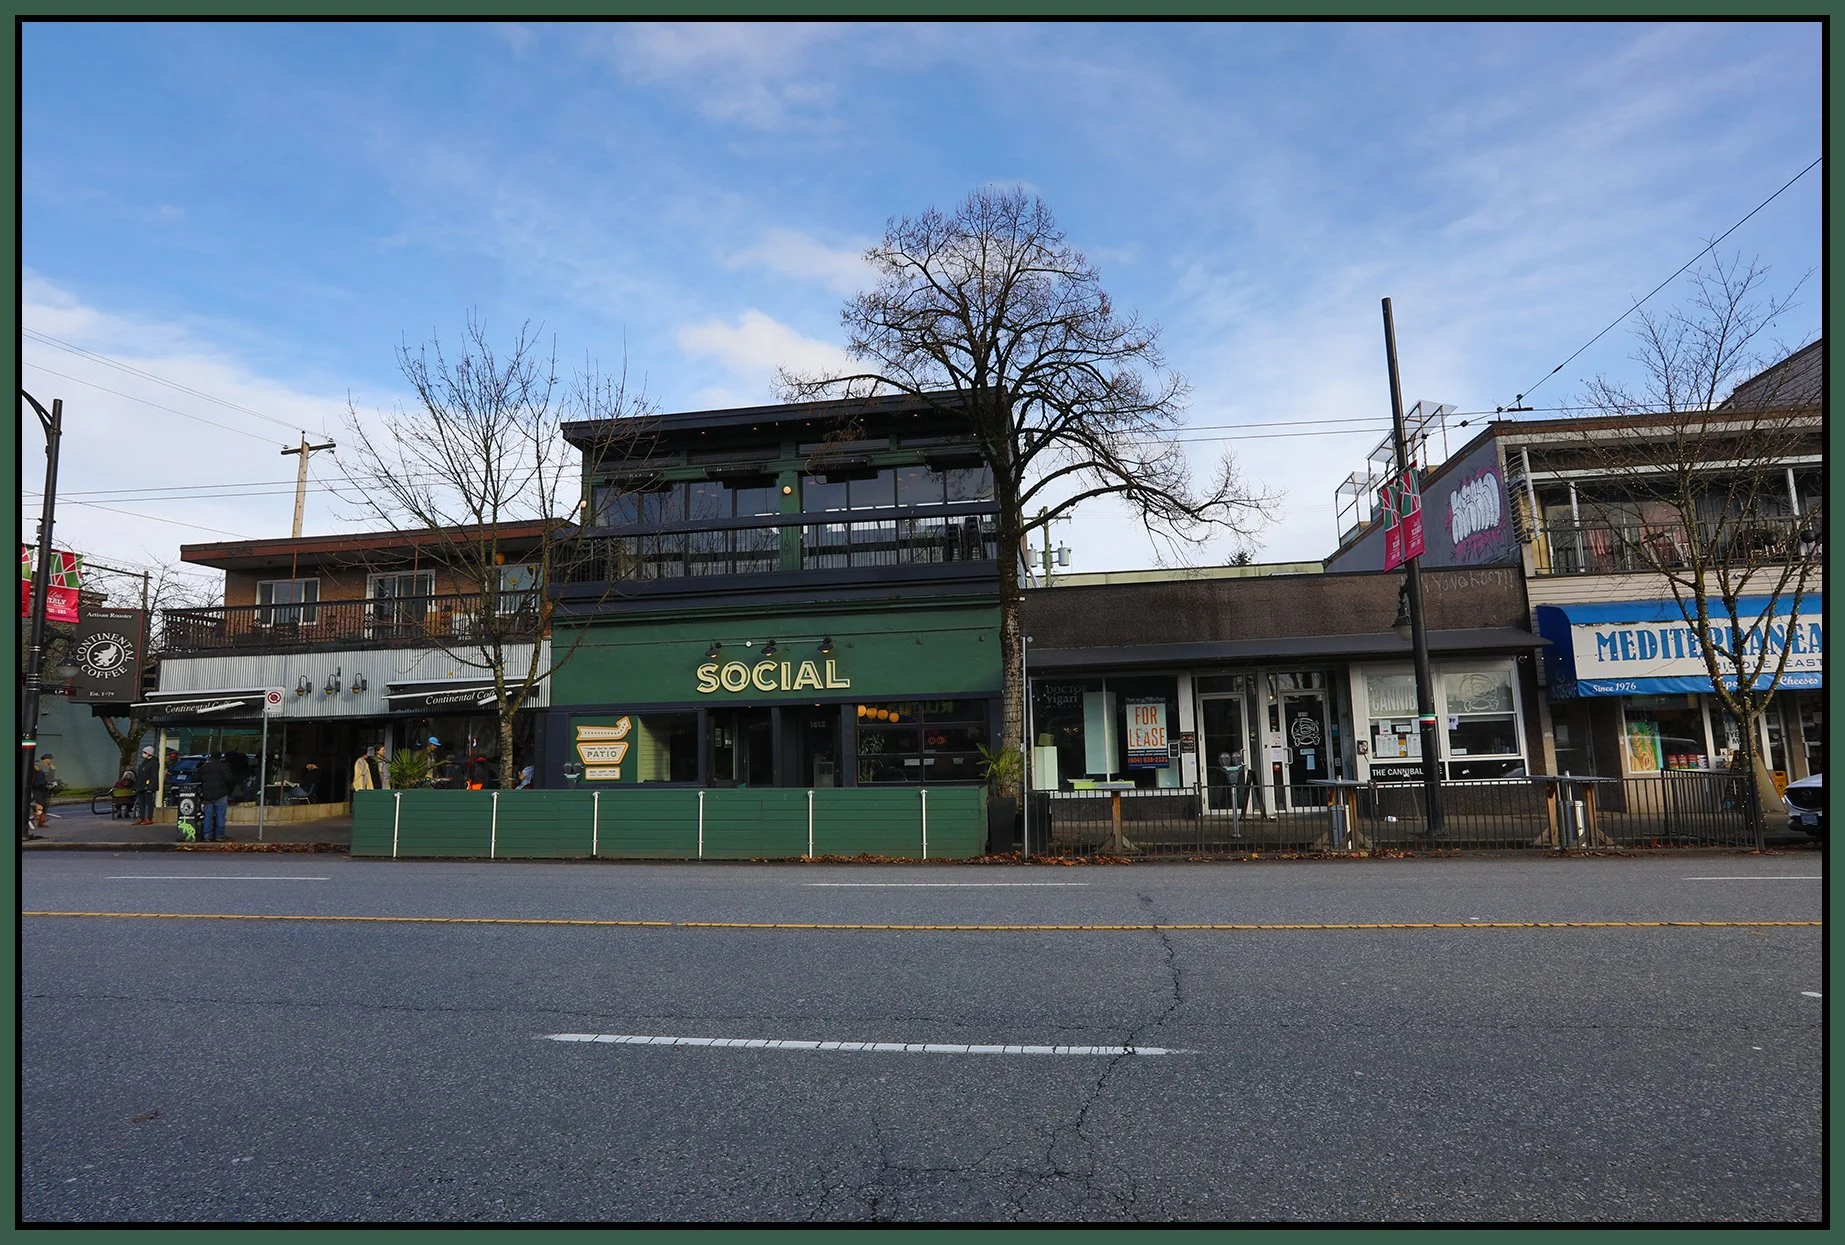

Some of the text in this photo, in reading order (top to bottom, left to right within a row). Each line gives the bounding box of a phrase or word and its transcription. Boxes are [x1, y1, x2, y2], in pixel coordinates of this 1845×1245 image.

[76, 632, 135, 661] CONTINENTAL
[81, 664, 128, 679] COFFEE
[696, 659, 850, 693] SOCIAL
[1592, 682, 1637, 692] Since 1976
[1780, 675, 1819, 686] Cheeses
[1046, 685, 1088, 695] DOCTOR
[425, 691, 475, 705] Continental
[1372, 686, 1419, 712] CANNIB
[165, 701, 211, 713] Continental
[1135, 706, 1157, 725] FOR
[1128, 727, 1166, 747] LEASE
[587, 750, 617, 758] PATIO
[1372, 767, 1424, 777] THE CANNIBAL
